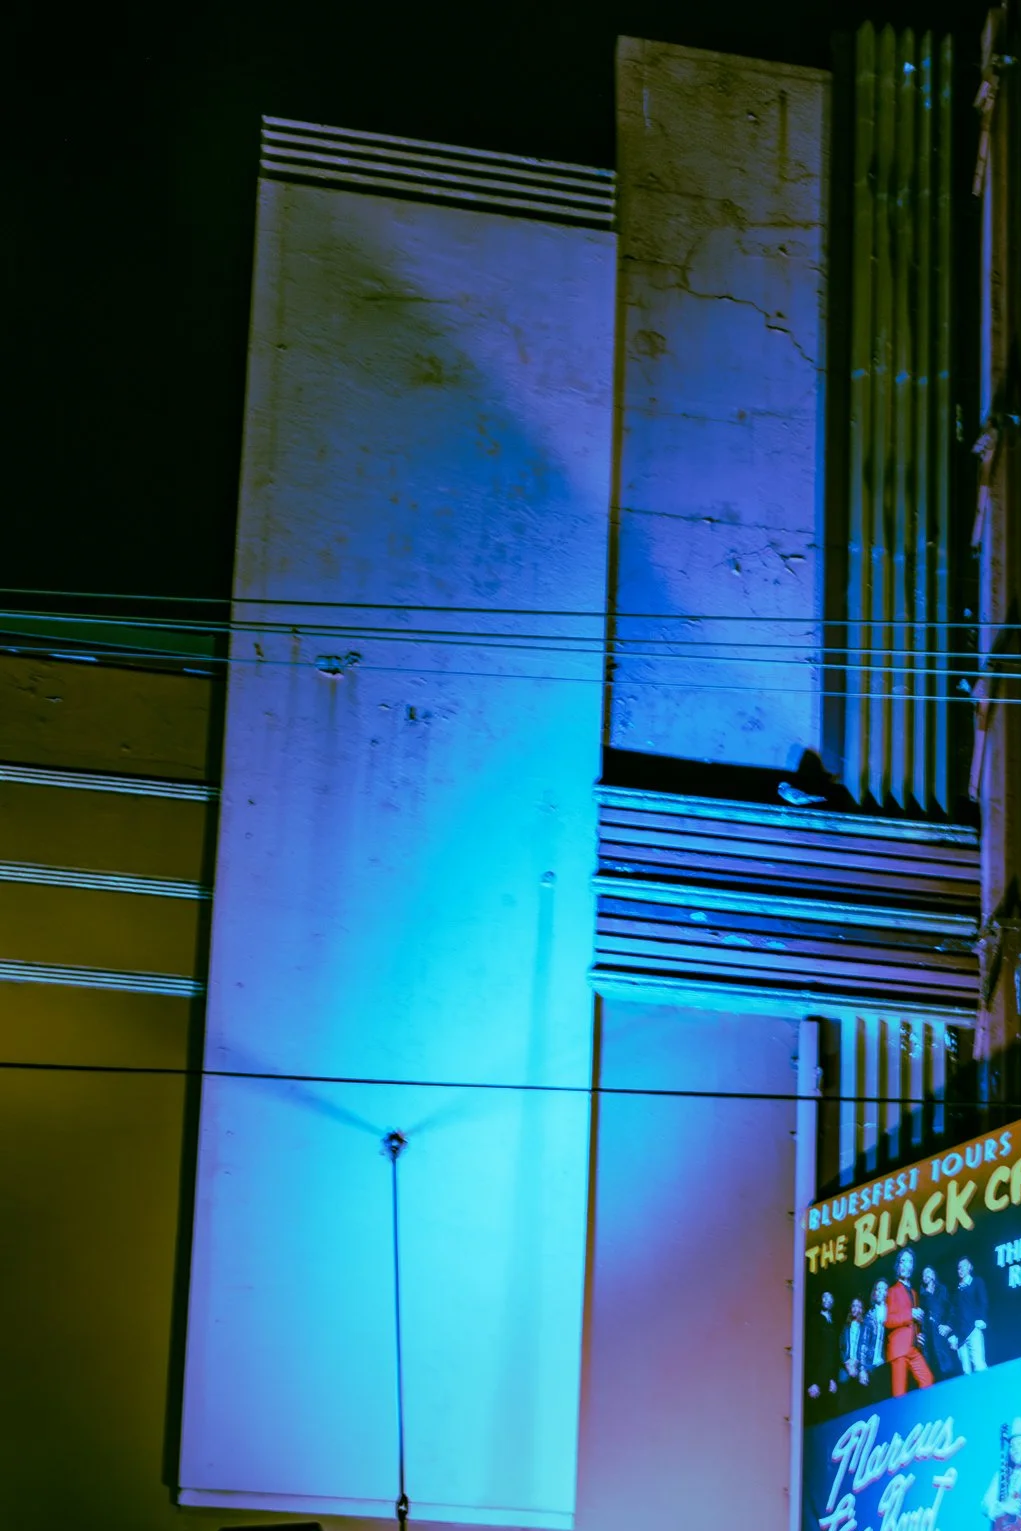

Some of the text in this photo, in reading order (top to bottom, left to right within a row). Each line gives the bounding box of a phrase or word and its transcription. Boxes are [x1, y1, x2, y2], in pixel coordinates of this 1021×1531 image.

[805, 1235, 848, 1275] THE
[854, 1180, 977, 1268] BLACK
[808, 1167, 920, 1231] BLUESFEST
[931, 1131, 1013, 1183] TOURS
[826, 1413, 967, 1512] Marcus
